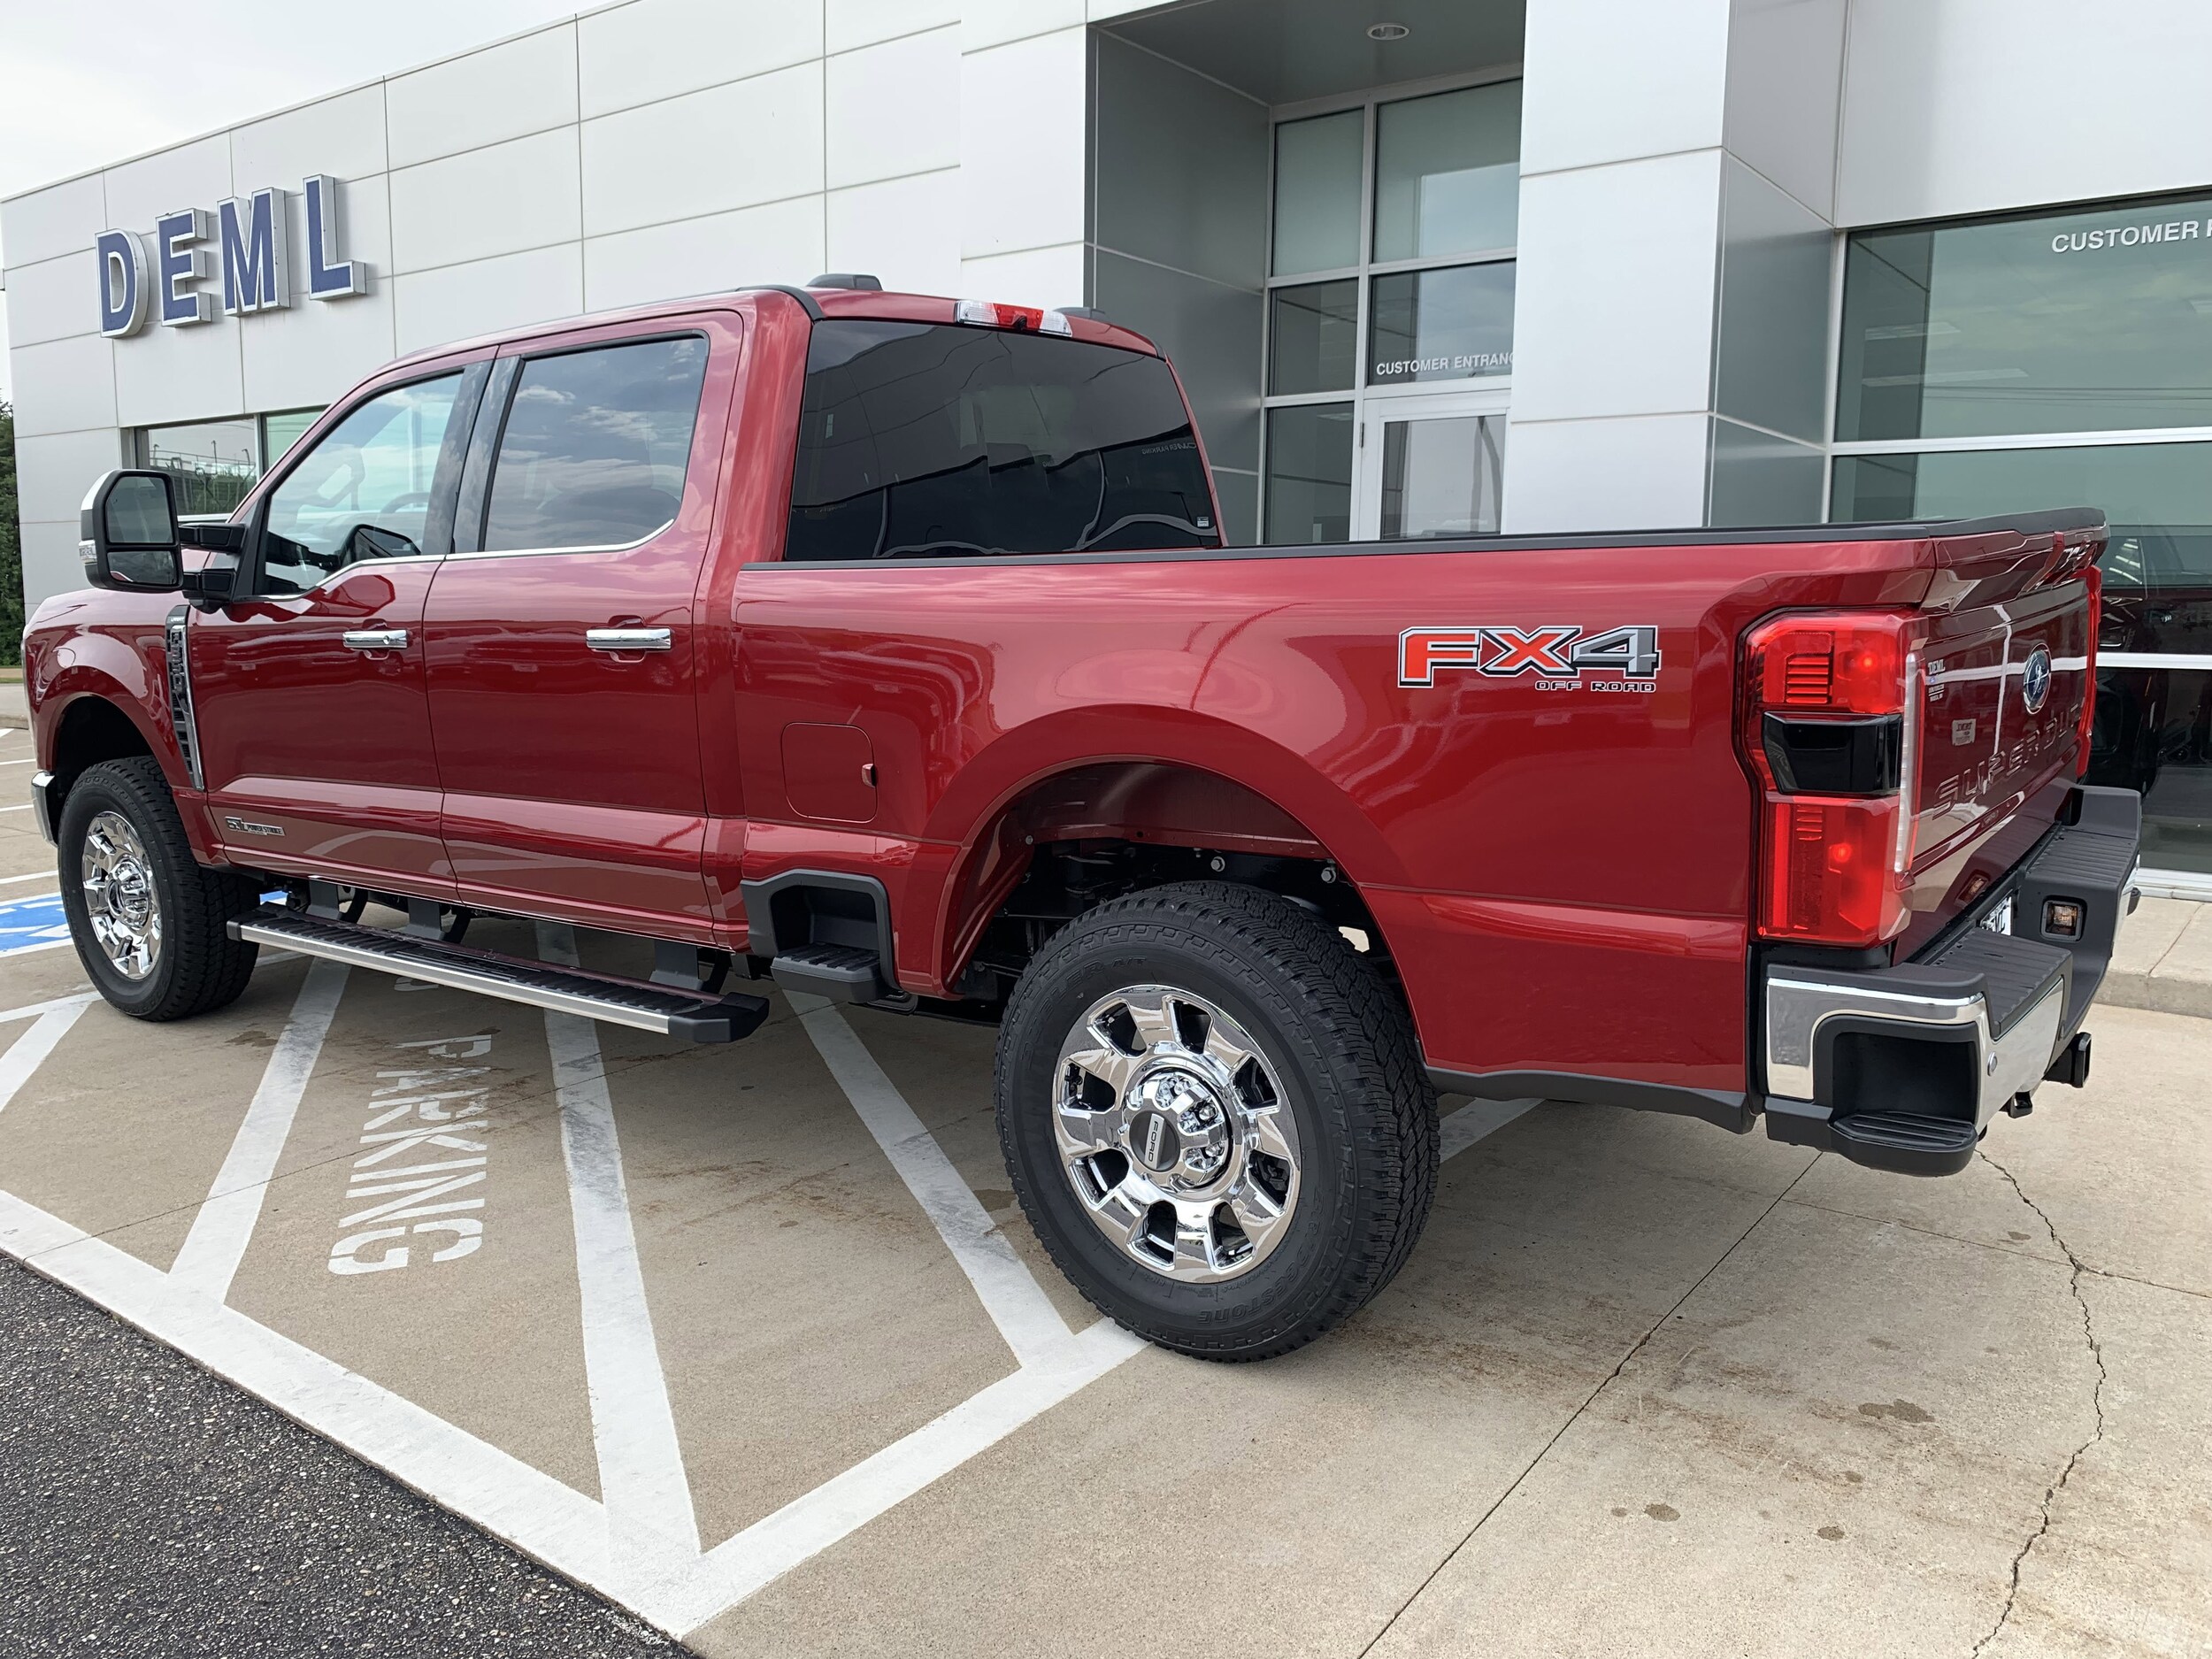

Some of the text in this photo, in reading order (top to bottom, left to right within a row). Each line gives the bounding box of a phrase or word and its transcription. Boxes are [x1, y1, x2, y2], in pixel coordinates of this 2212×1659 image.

[95, 174, 366, 338] DEML
[2051, 220, 2200, 253] CUSTOMER
[1376, 357, 1448, 375] CUSTOMER
[1398, 626, 1661, 687] FX4
[1534, 680, 1656, 693] OFF ROAD
[1932, 728, 2041, 821] SUPER
[328, 1034, 492, 1275] PARKING
[1148, 1120, 1159, 1163] FORD
